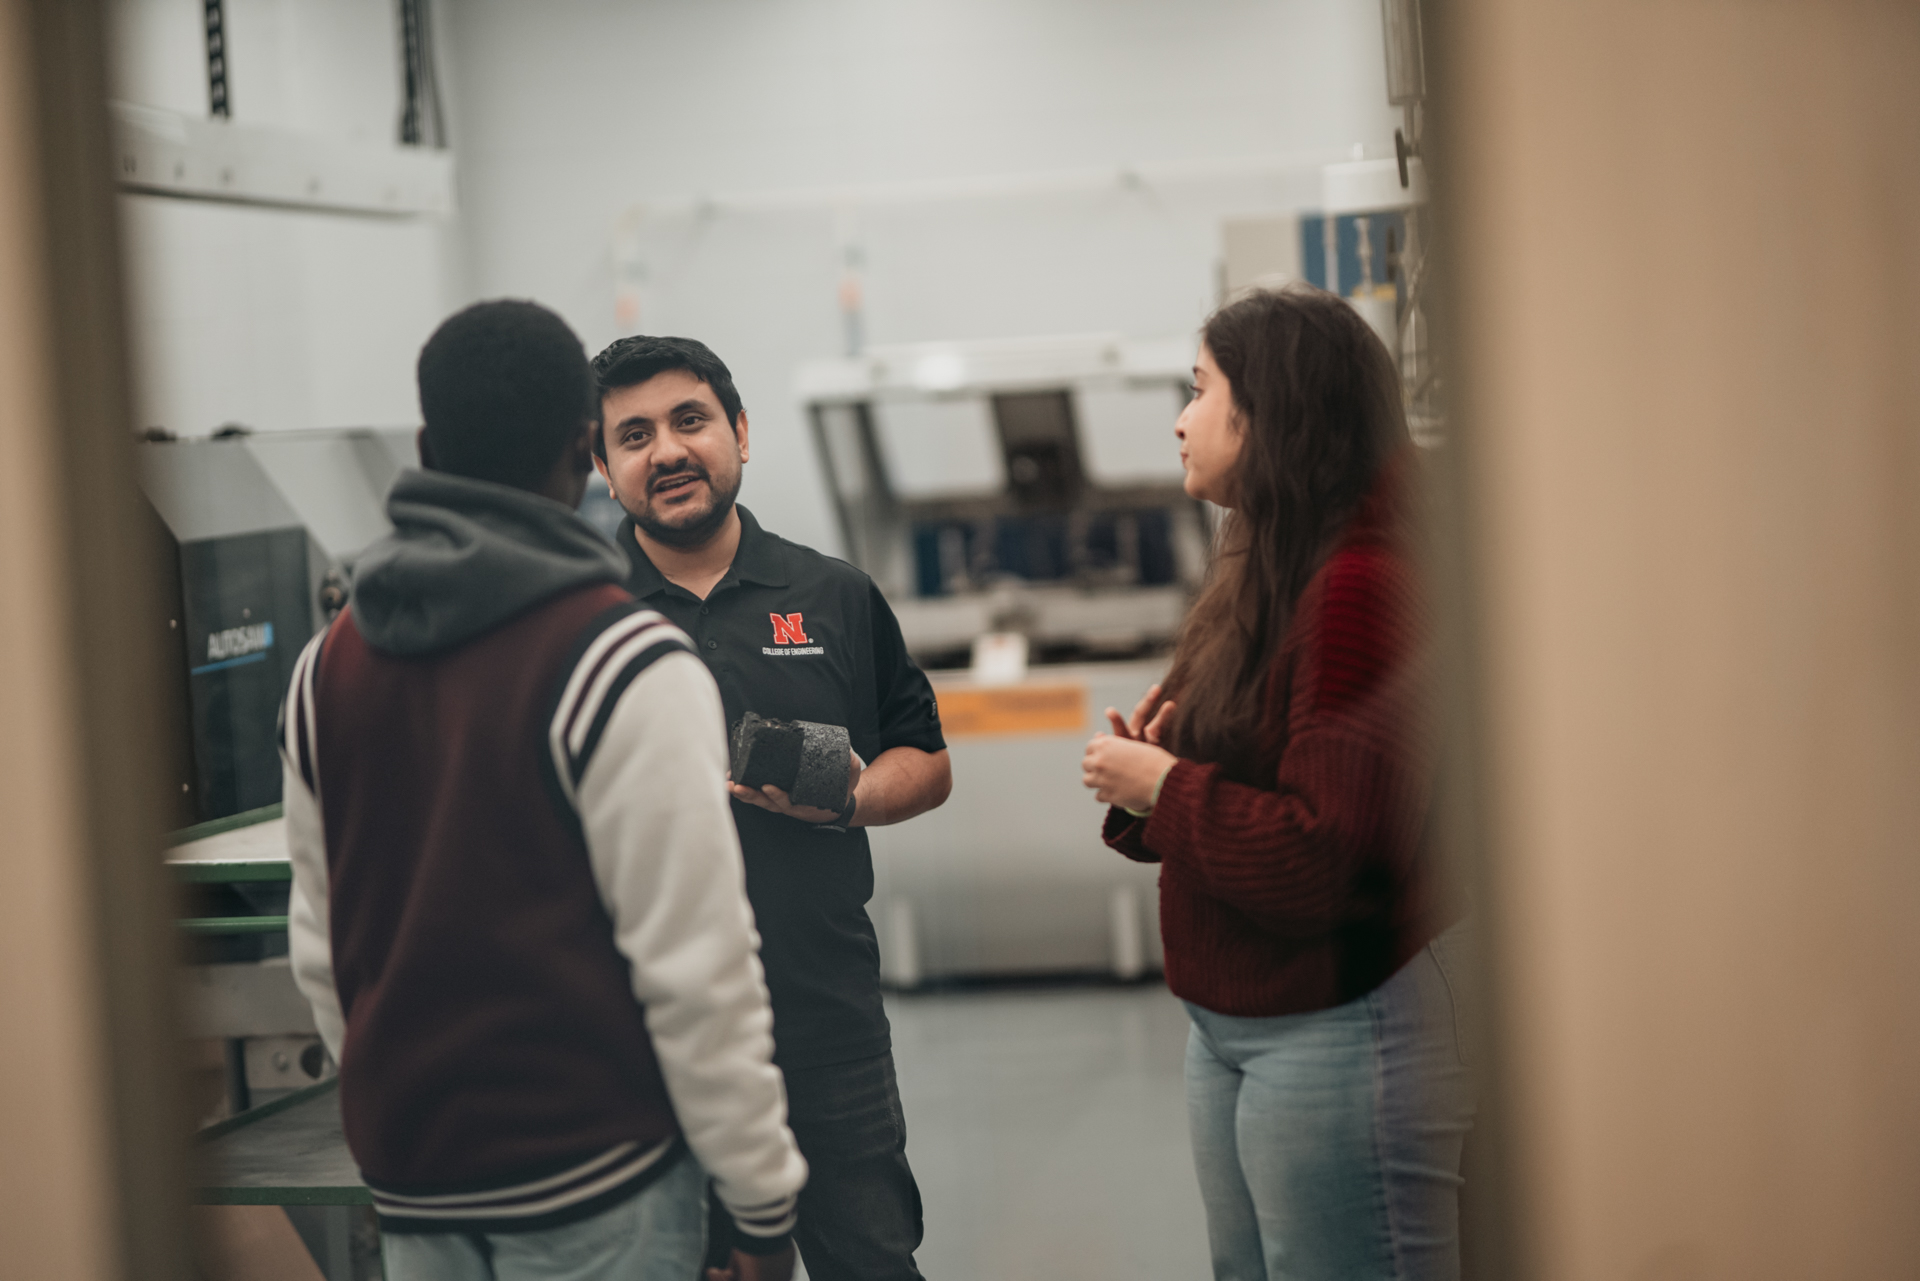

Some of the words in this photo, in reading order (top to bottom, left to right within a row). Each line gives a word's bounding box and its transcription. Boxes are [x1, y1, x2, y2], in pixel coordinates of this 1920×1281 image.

[769, 612, 808, 645] N
[762, 647, 784, 655] COLLEGE
[791, 647, 824, 655] ENGINEERING
